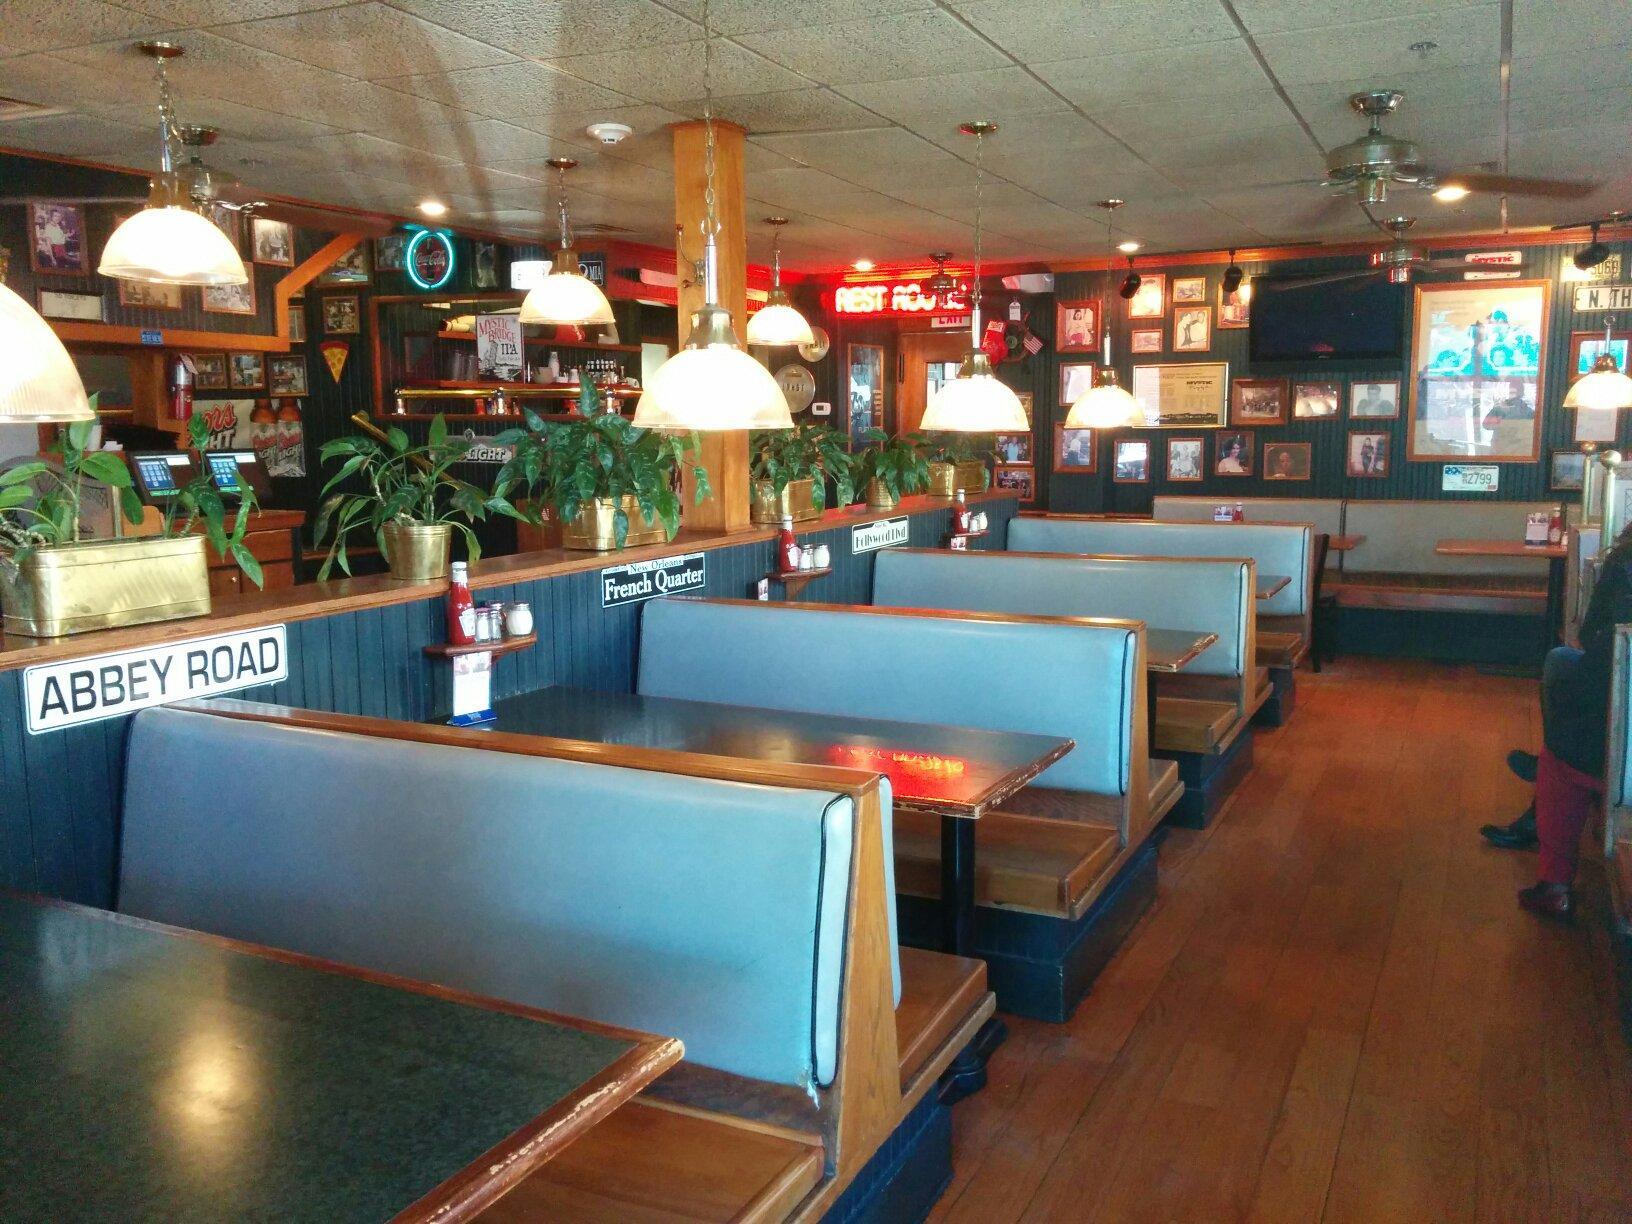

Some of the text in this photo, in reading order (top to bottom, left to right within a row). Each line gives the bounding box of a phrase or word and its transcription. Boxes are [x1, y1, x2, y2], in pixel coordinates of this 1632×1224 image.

[1471, 255, 1514, 263] MYSTIC
[835, 284, 888, 313] REST
[1588, 289, 1604, 308] N.
[478, 317, 511, 335] MYSTIC
[488, 327, 515, 343] BRIDGE
[500, 343, 518, 355] IPA
[467, 447, 506, 462] LIGHT
[1467, 473, 1492, 485] 2799
[630, 563, 649, 574] New
[651, 559, 683, 570] Orleans
[604, 568, 704, 601] French Quarter
[39, 635, 280, 720] ABBEY ROAD
